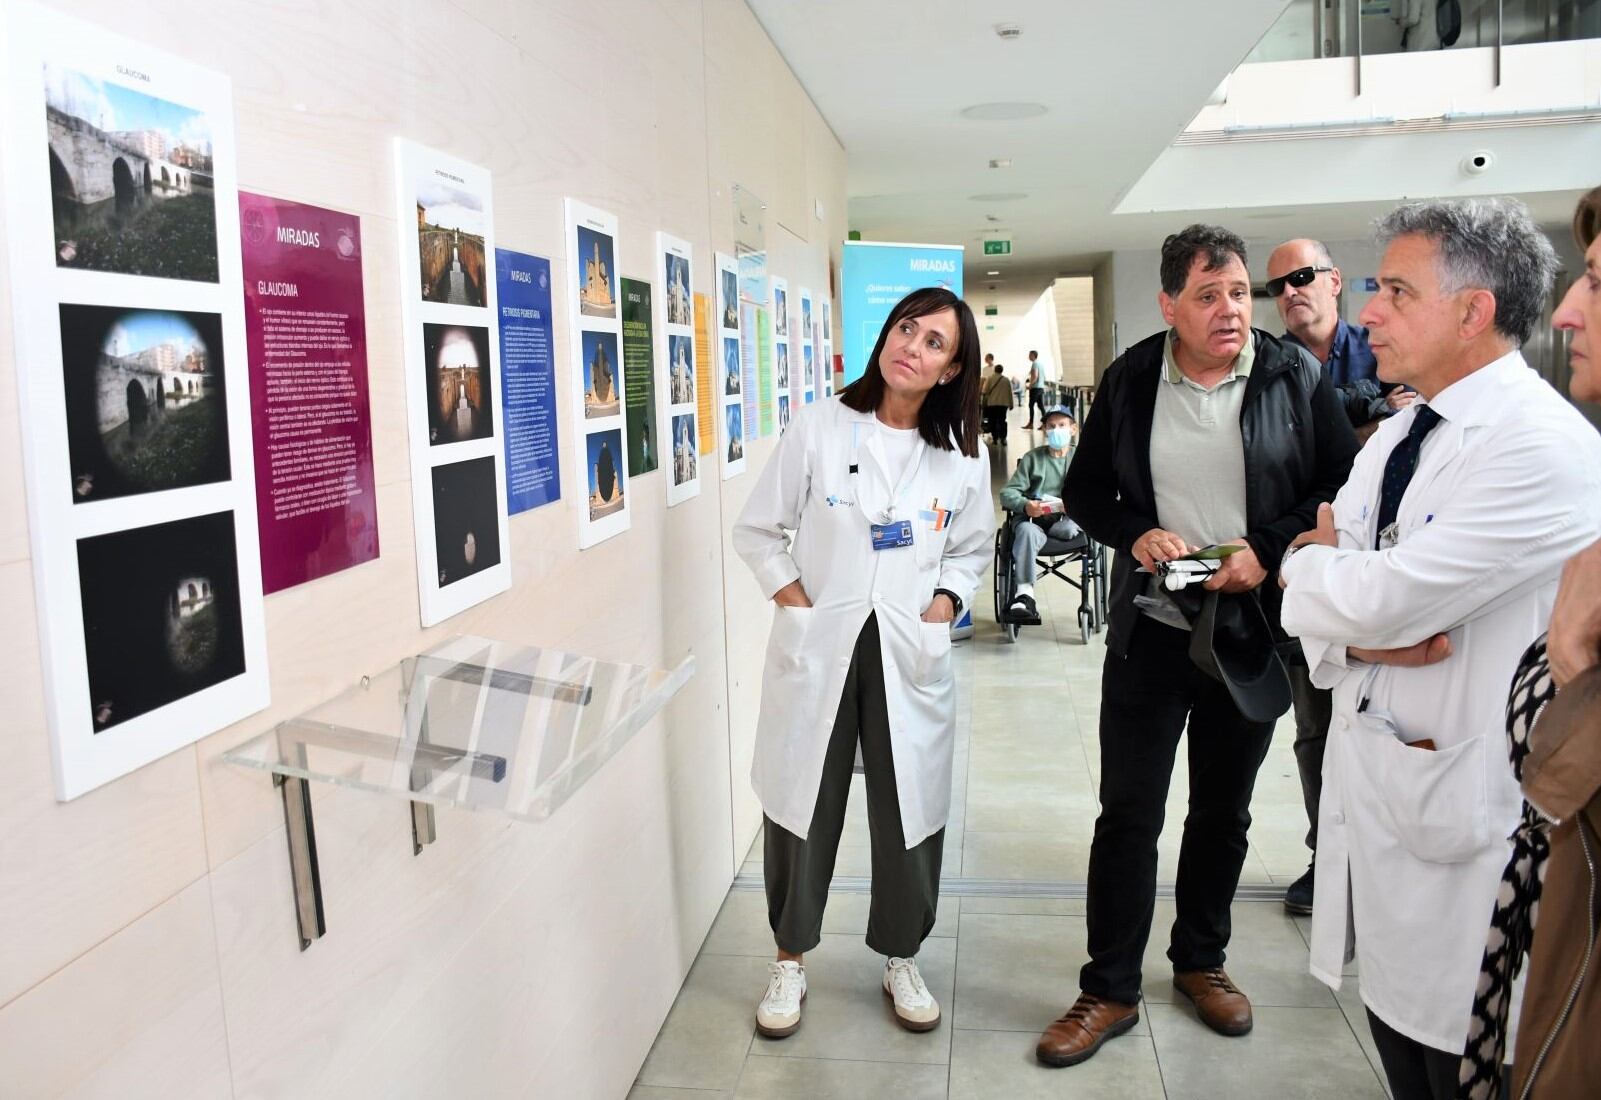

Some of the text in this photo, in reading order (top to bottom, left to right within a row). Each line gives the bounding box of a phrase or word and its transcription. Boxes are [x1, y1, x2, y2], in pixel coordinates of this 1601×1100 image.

[116, 64, 151, 82] GLAUCOMA
[277, 226, 320, 248] MIRADAS
[911, 259, 956, 272] MIRADAS
[511, 270, 532, 284] MIRADAS
[258, 281, 299, 297] GLAUCOMA
[896, 538, 913, 546] Sacyl
